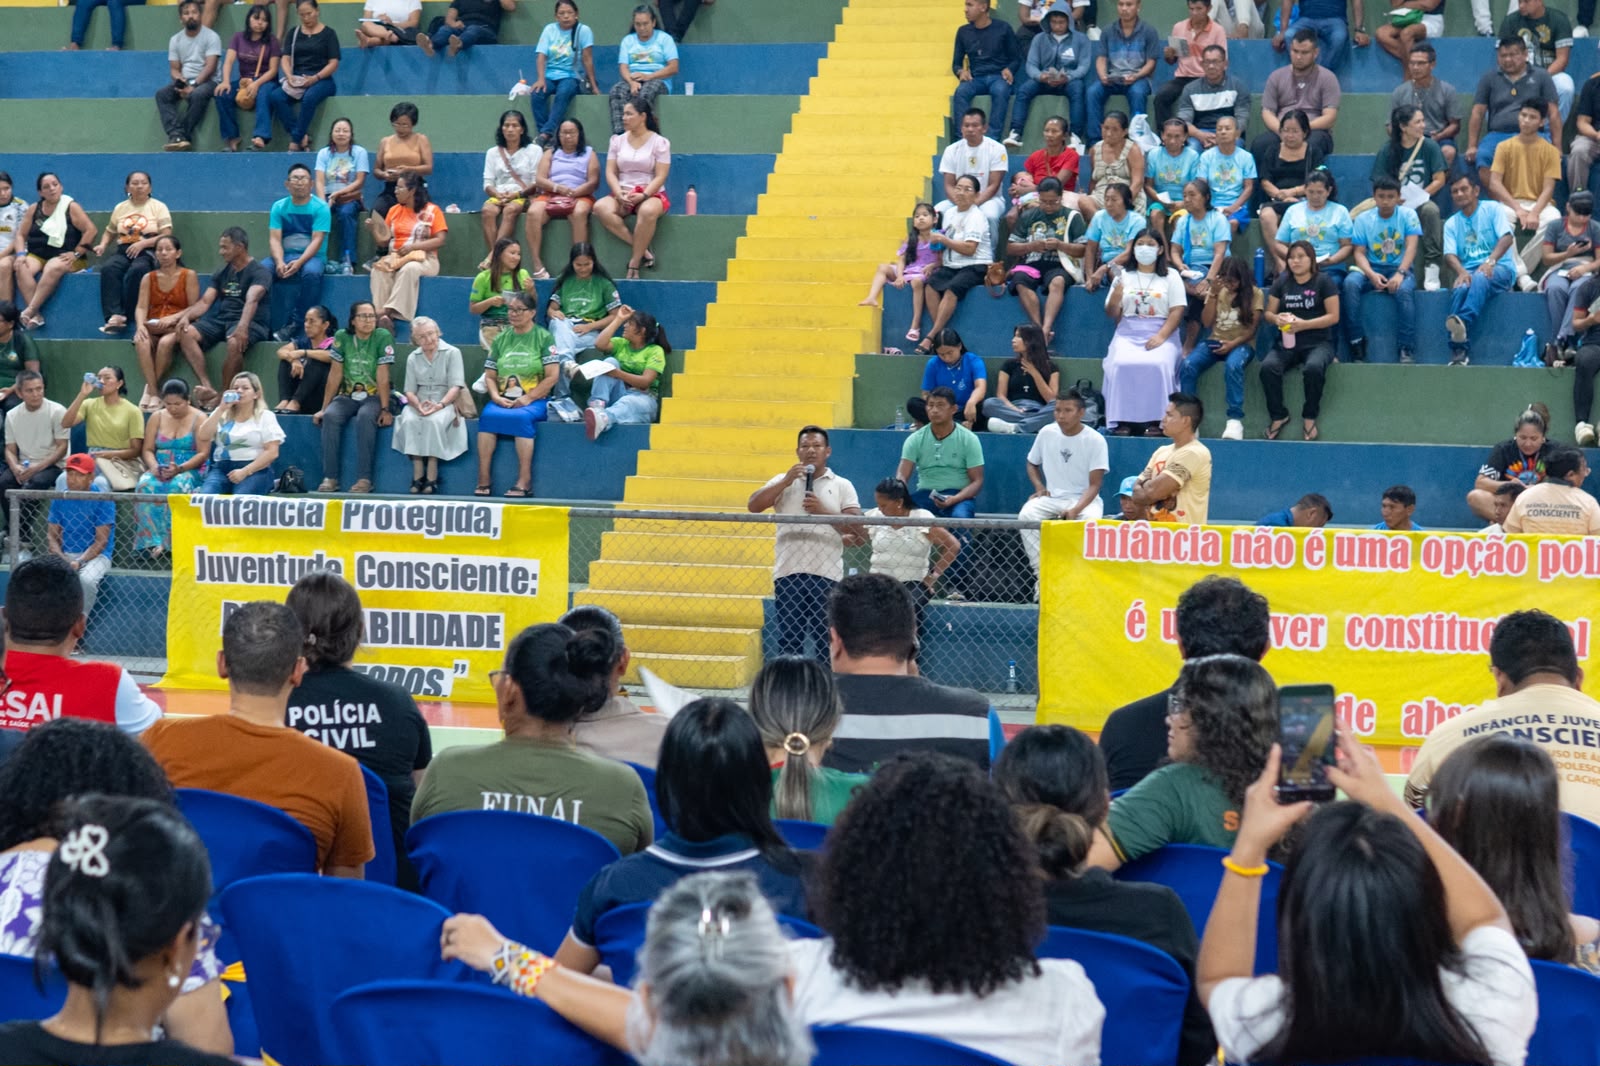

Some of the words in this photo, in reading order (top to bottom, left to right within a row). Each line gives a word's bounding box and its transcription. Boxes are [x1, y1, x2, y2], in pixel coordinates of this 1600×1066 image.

[1527, 508, 1581, 519] CONSCIENTE
[1085, 521, 1220, 563] infância
[1231, 527, 1294, 565] não
[1305, 530, 1324, 567] é
[1335, 536, 1409, 570] uma
[1422, 535, 1527, 577] opção
[356, 554, 537, 596] Consciente:
[1126, 601, 1146, 639] é
[288, 699, 382, 726] POLÍCIA
[1463, 714, 1543, 737] INFÂNCIA
[1546, 714, 1556, 724] E
